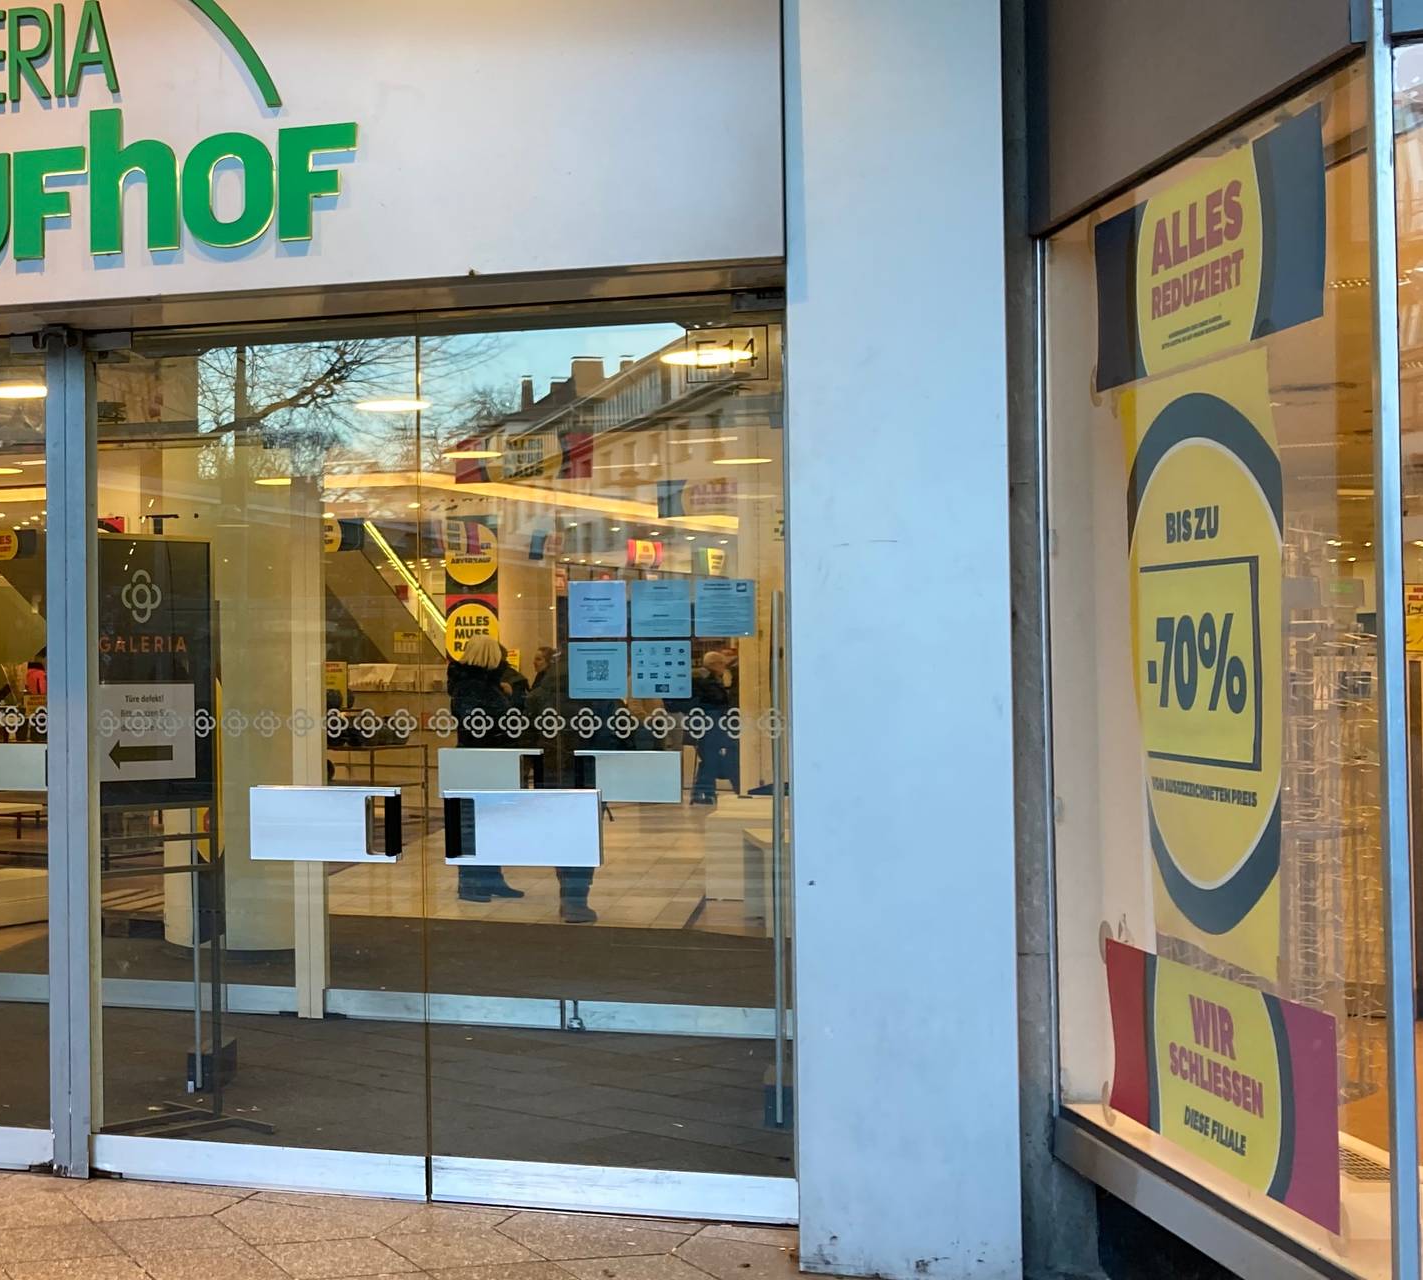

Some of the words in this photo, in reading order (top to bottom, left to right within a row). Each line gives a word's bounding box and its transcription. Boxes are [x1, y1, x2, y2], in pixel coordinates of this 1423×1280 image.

[1151, 179, 1244, 276] ALLES
[1151, 248, 1244, 320] REDUZIERT
[1165, 509, 1191, 544] BIS
[1194, 504, 1220, 540] ZU
[99, 635, 187, 653] GALERIA
[455, 616, 489, 626] ALLES
[1147, 611, 1248, 715] -70%
[1232, 788, 1258, 808] PREIS
[1188, 994, 1237, 1061] WIR
[1169, 1042, 1264, 1119] SCHLIESSEN
[1183, 1105, 1209, 1137] DIESE
[1211, 1119, 1247, 1157] FILIALE
